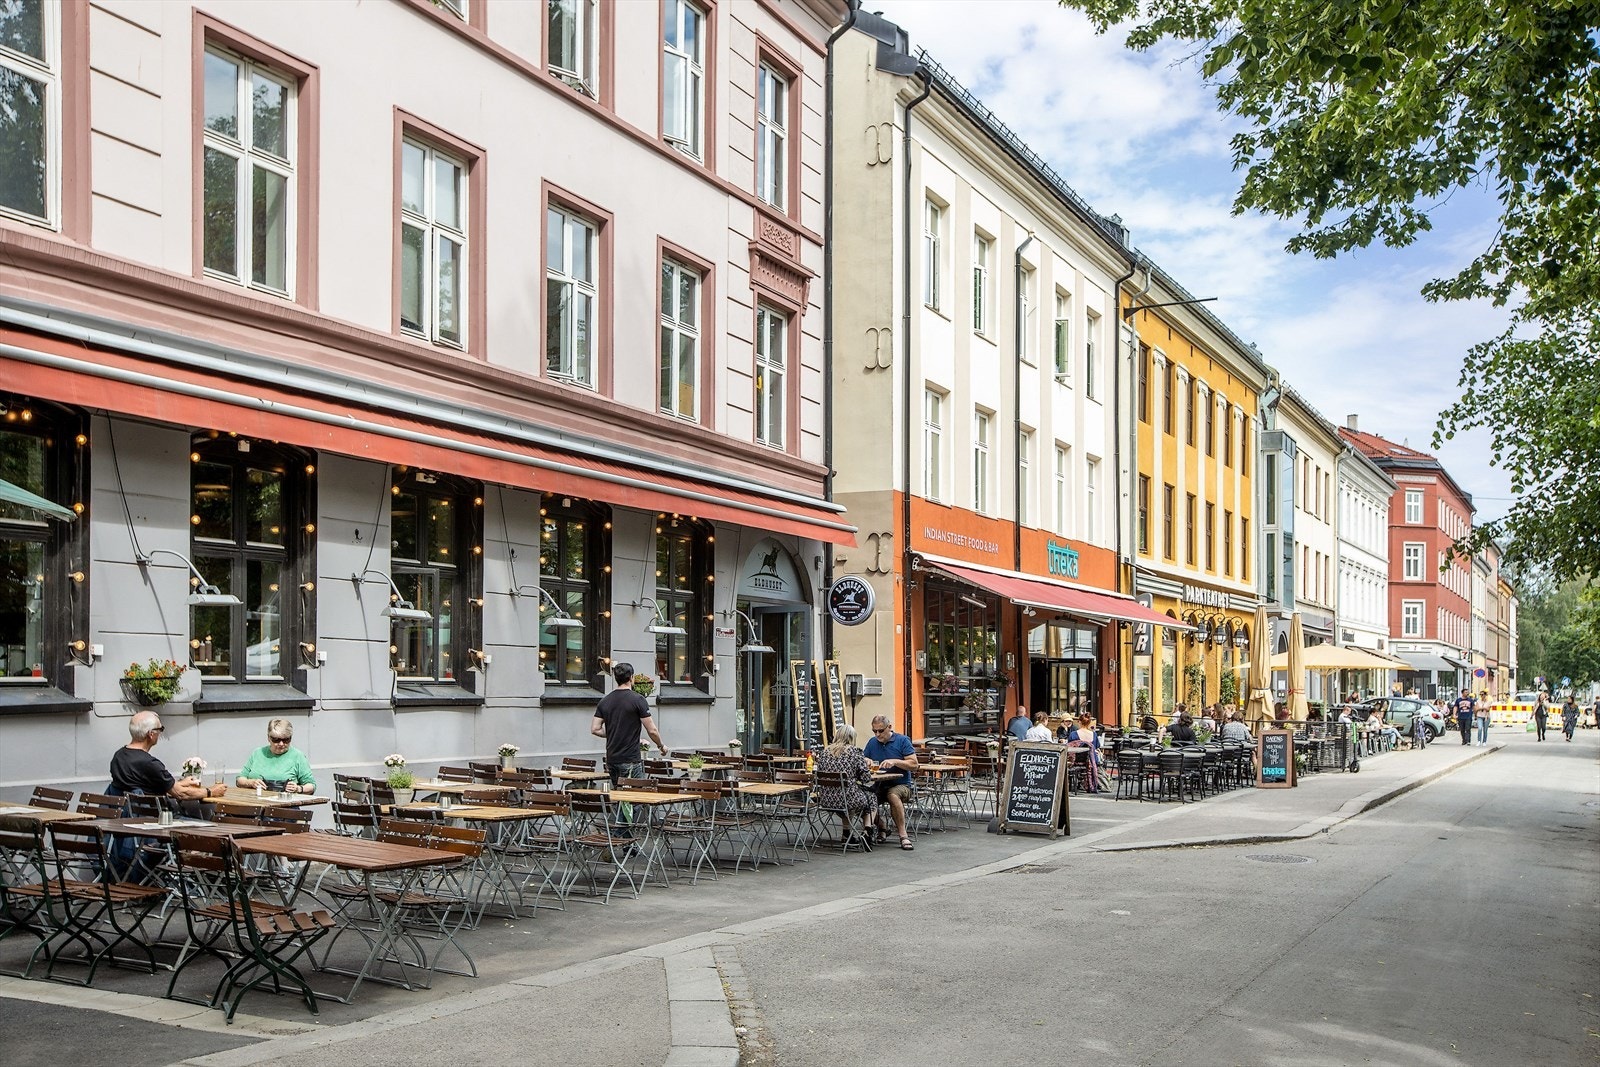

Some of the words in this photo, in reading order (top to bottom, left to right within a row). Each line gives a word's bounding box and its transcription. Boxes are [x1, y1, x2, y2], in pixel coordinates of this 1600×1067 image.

[924, 527, 946, 542] INDIAN
[947, 532, 967, 546] STREET
[968, 537, 983, 550] FOOD
[984, 541, 988, 551] &
[988, 542, 998, 554] BAR
[1048, 540, 1078, 579] theka
[754, 578, 782, 590] ELDHUSET
[1186, 584, 1228, 608] PARKTEATRET
[1262, 766, 1286, 776] theka
